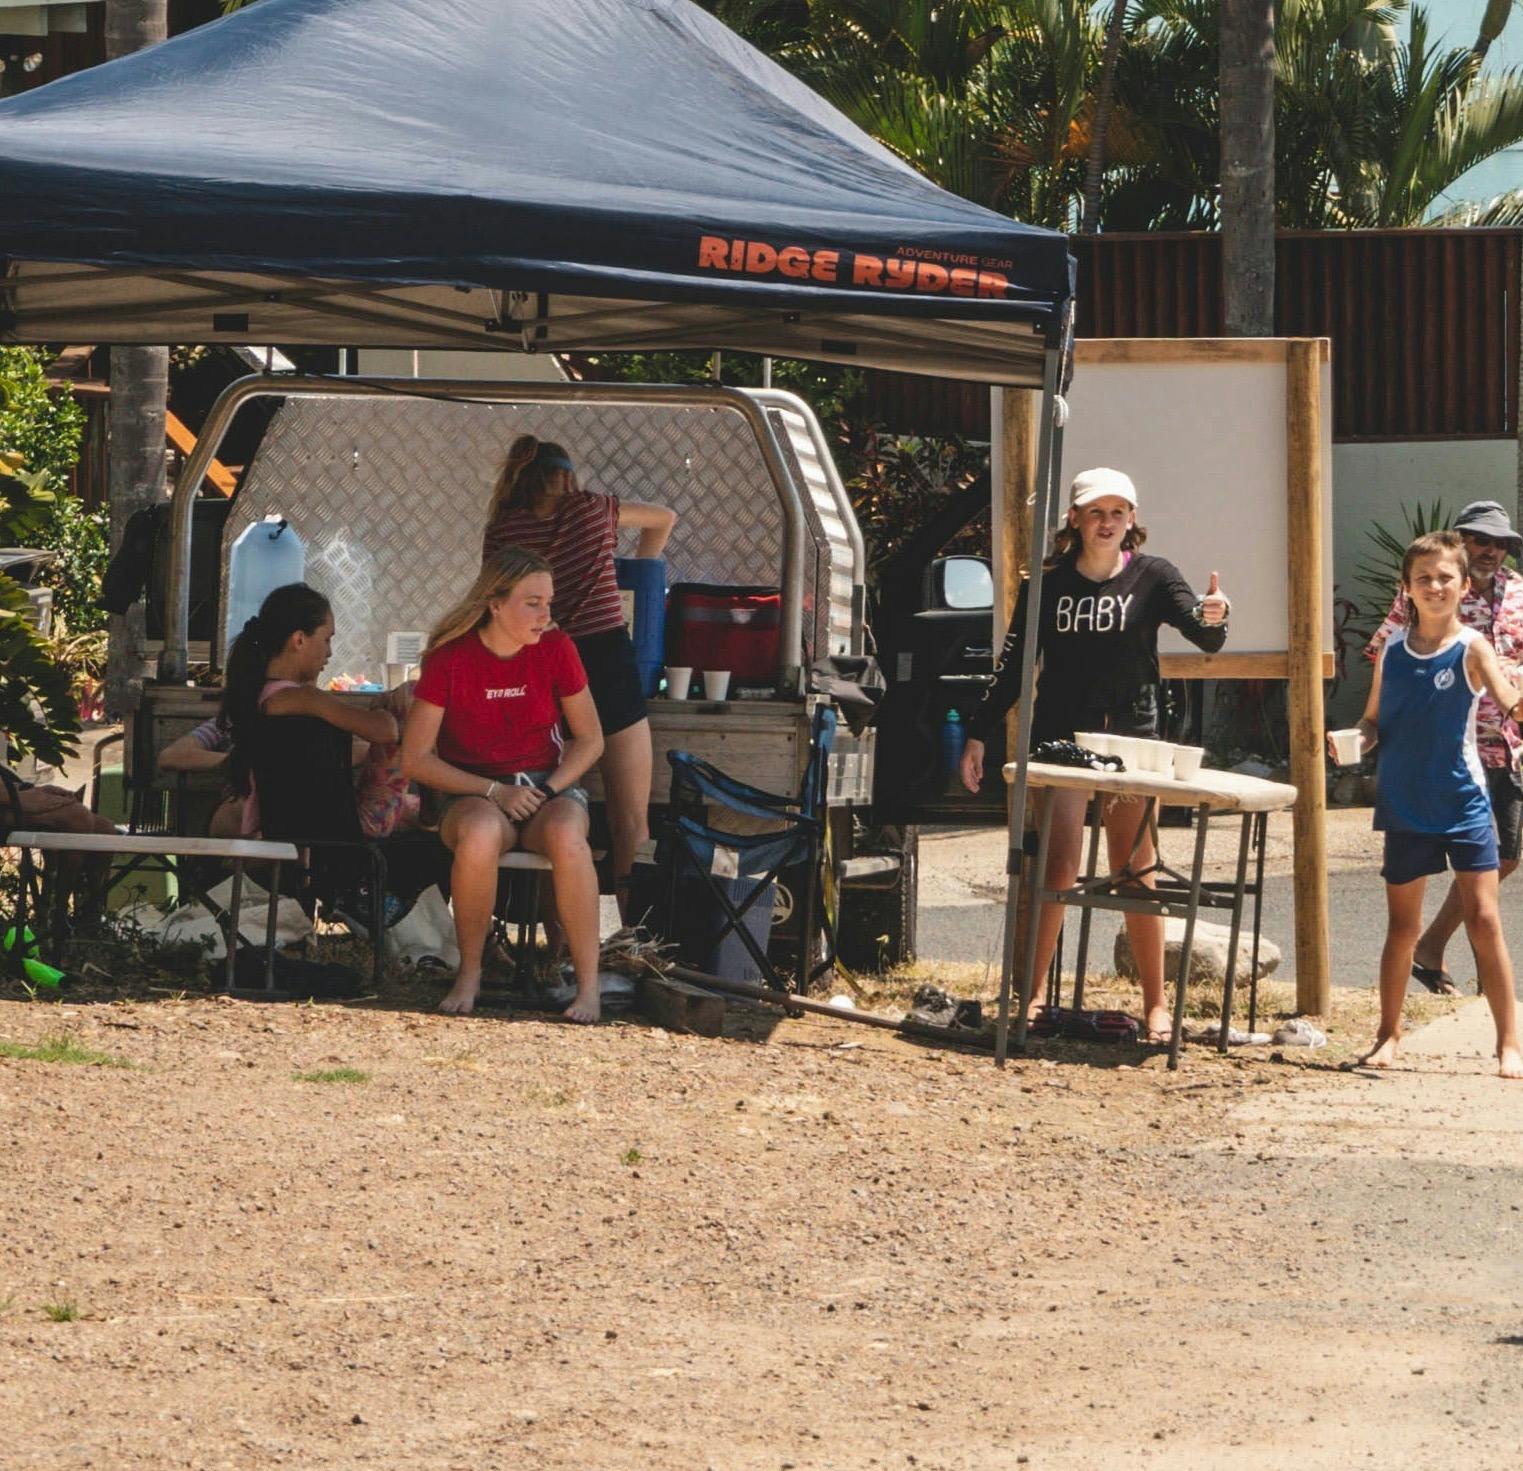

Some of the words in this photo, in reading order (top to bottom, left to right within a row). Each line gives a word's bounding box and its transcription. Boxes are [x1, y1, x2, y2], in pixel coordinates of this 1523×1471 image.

[698, 235, 840, 282] RIDGE
[852, 249, 1009, 300] RYDER
[897, 247, 979, 266] ADVENTURE
[1056, 593, 1134, 633] BABY
